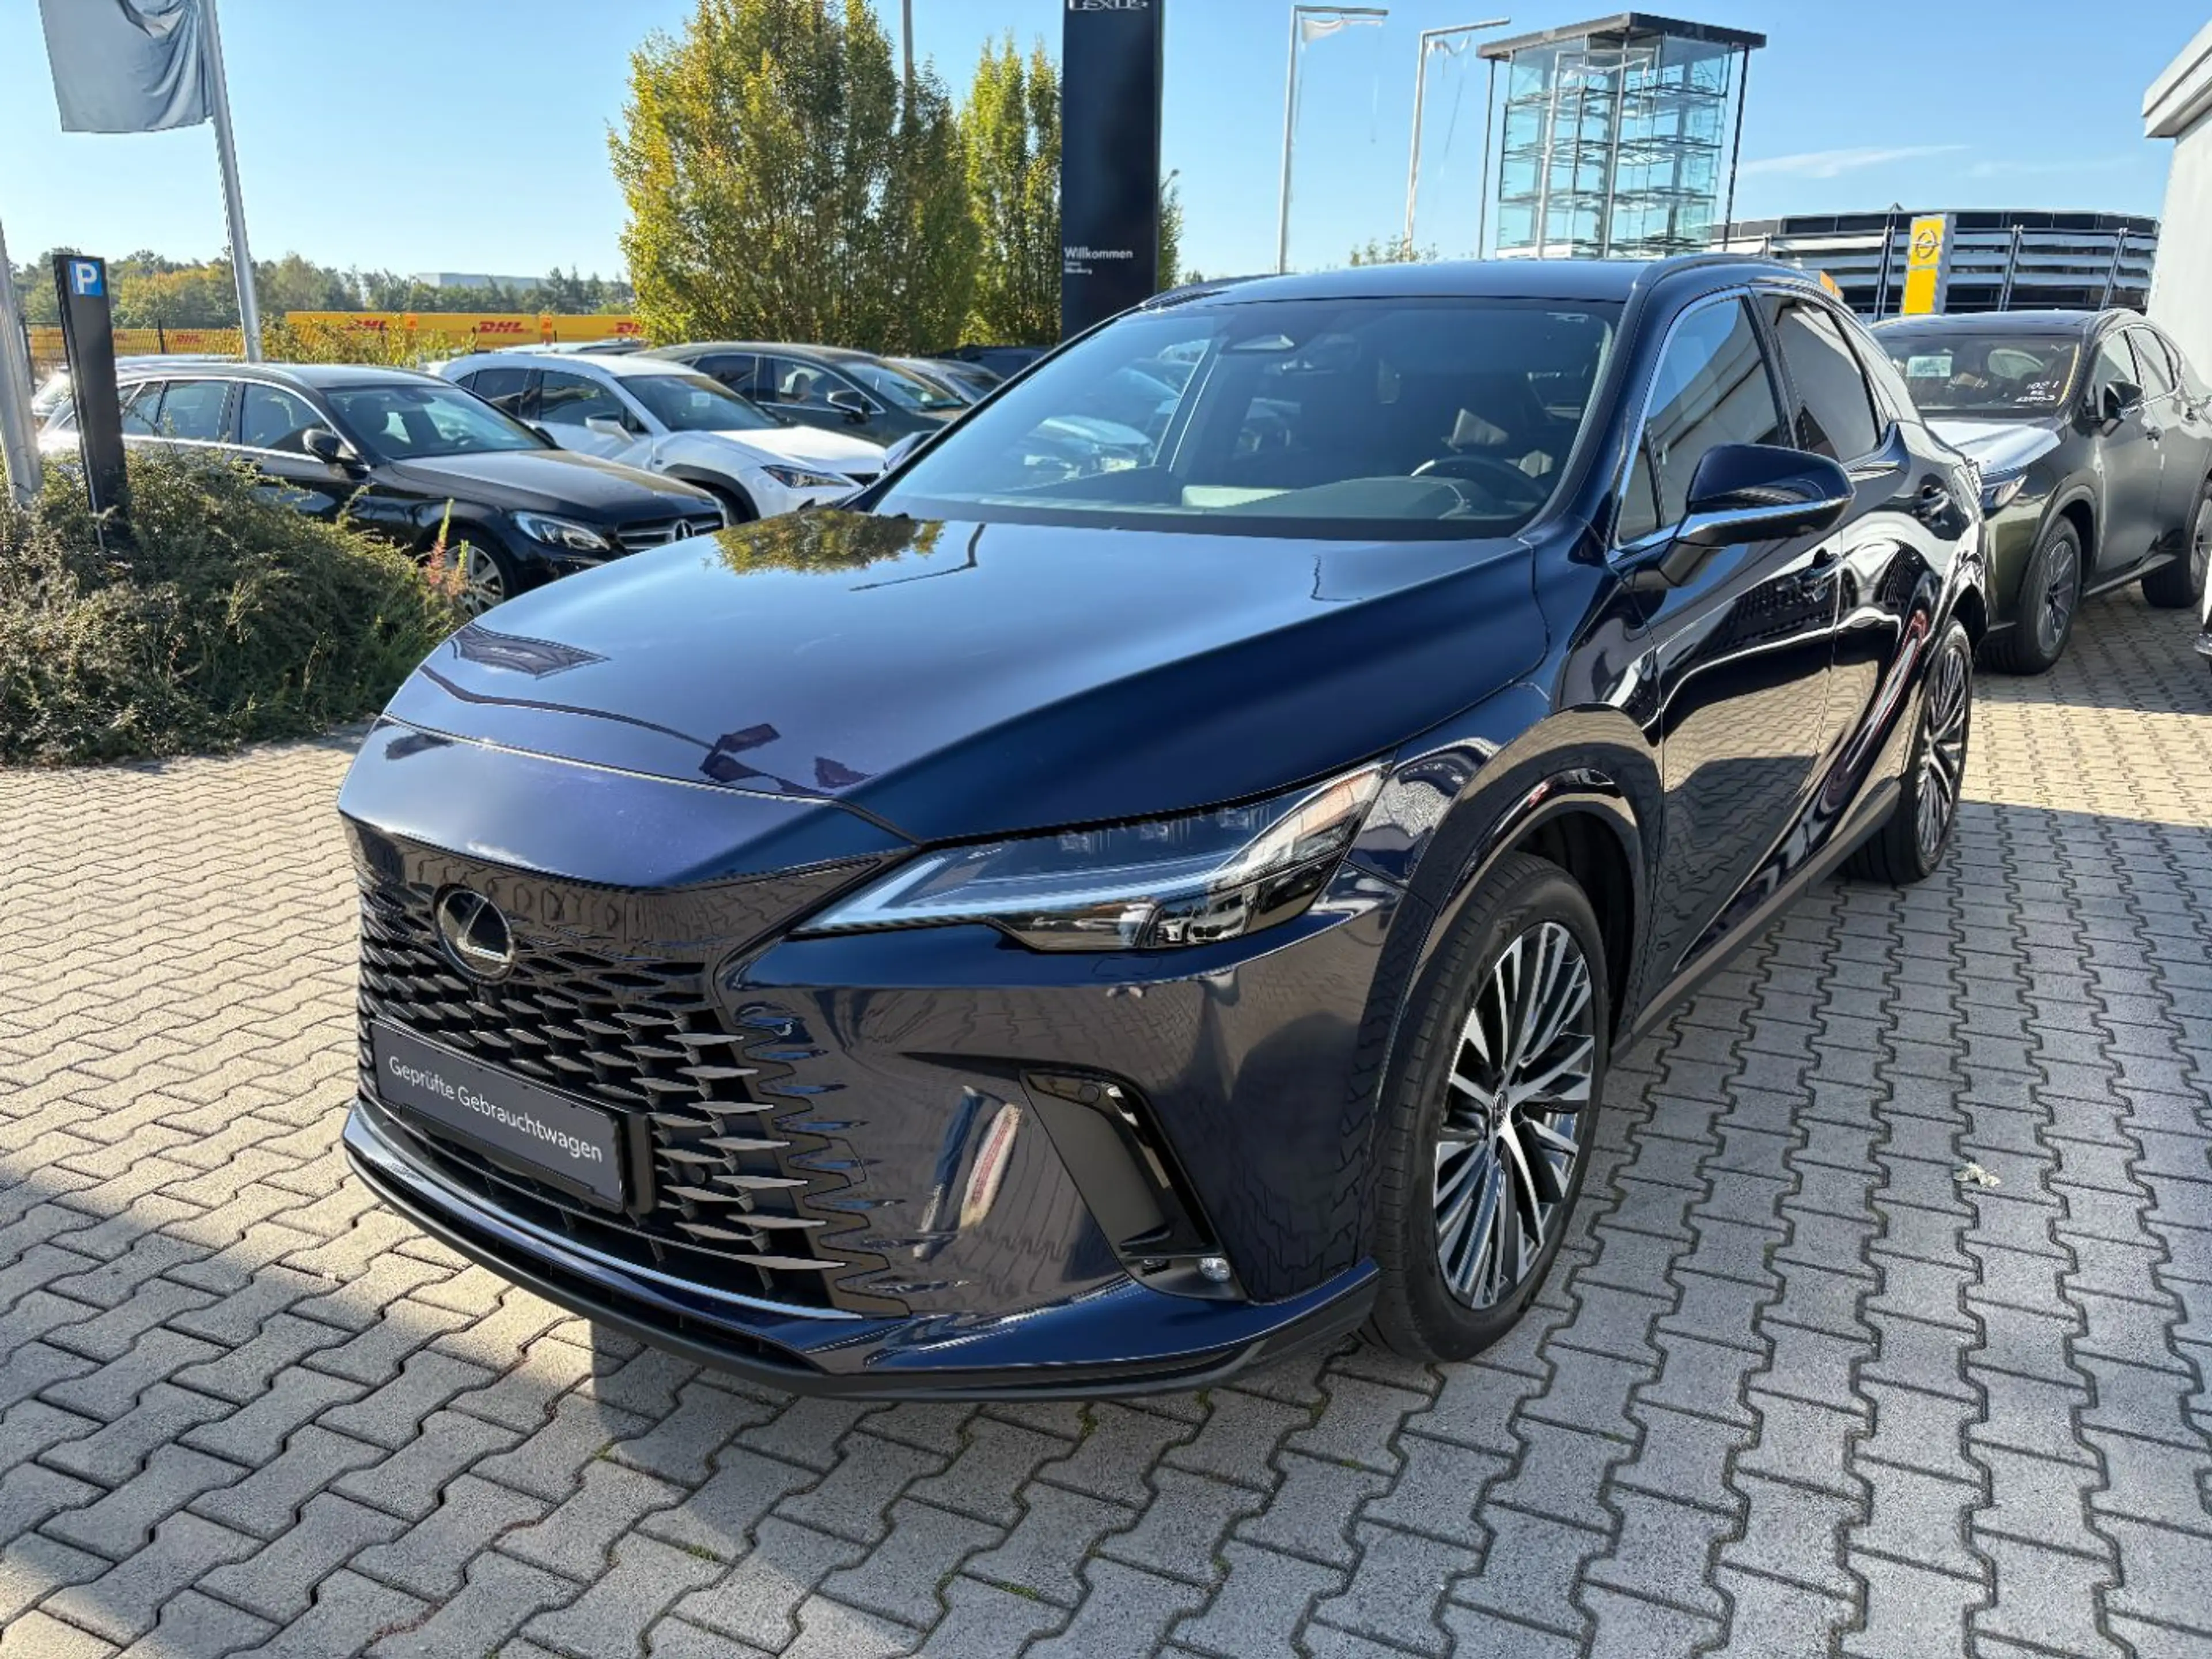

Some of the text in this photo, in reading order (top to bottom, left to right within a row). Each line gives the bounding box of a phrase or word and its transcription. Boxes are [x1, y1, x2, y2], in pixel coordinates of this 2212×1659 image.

[1063, 247, 1134, 260] Willkommen
[75, 263, 97, 294] P
[479, 321, 525, 333] DHL
[389, 1055, 603, 1164] Geprüfte Gebrauchtwagen
